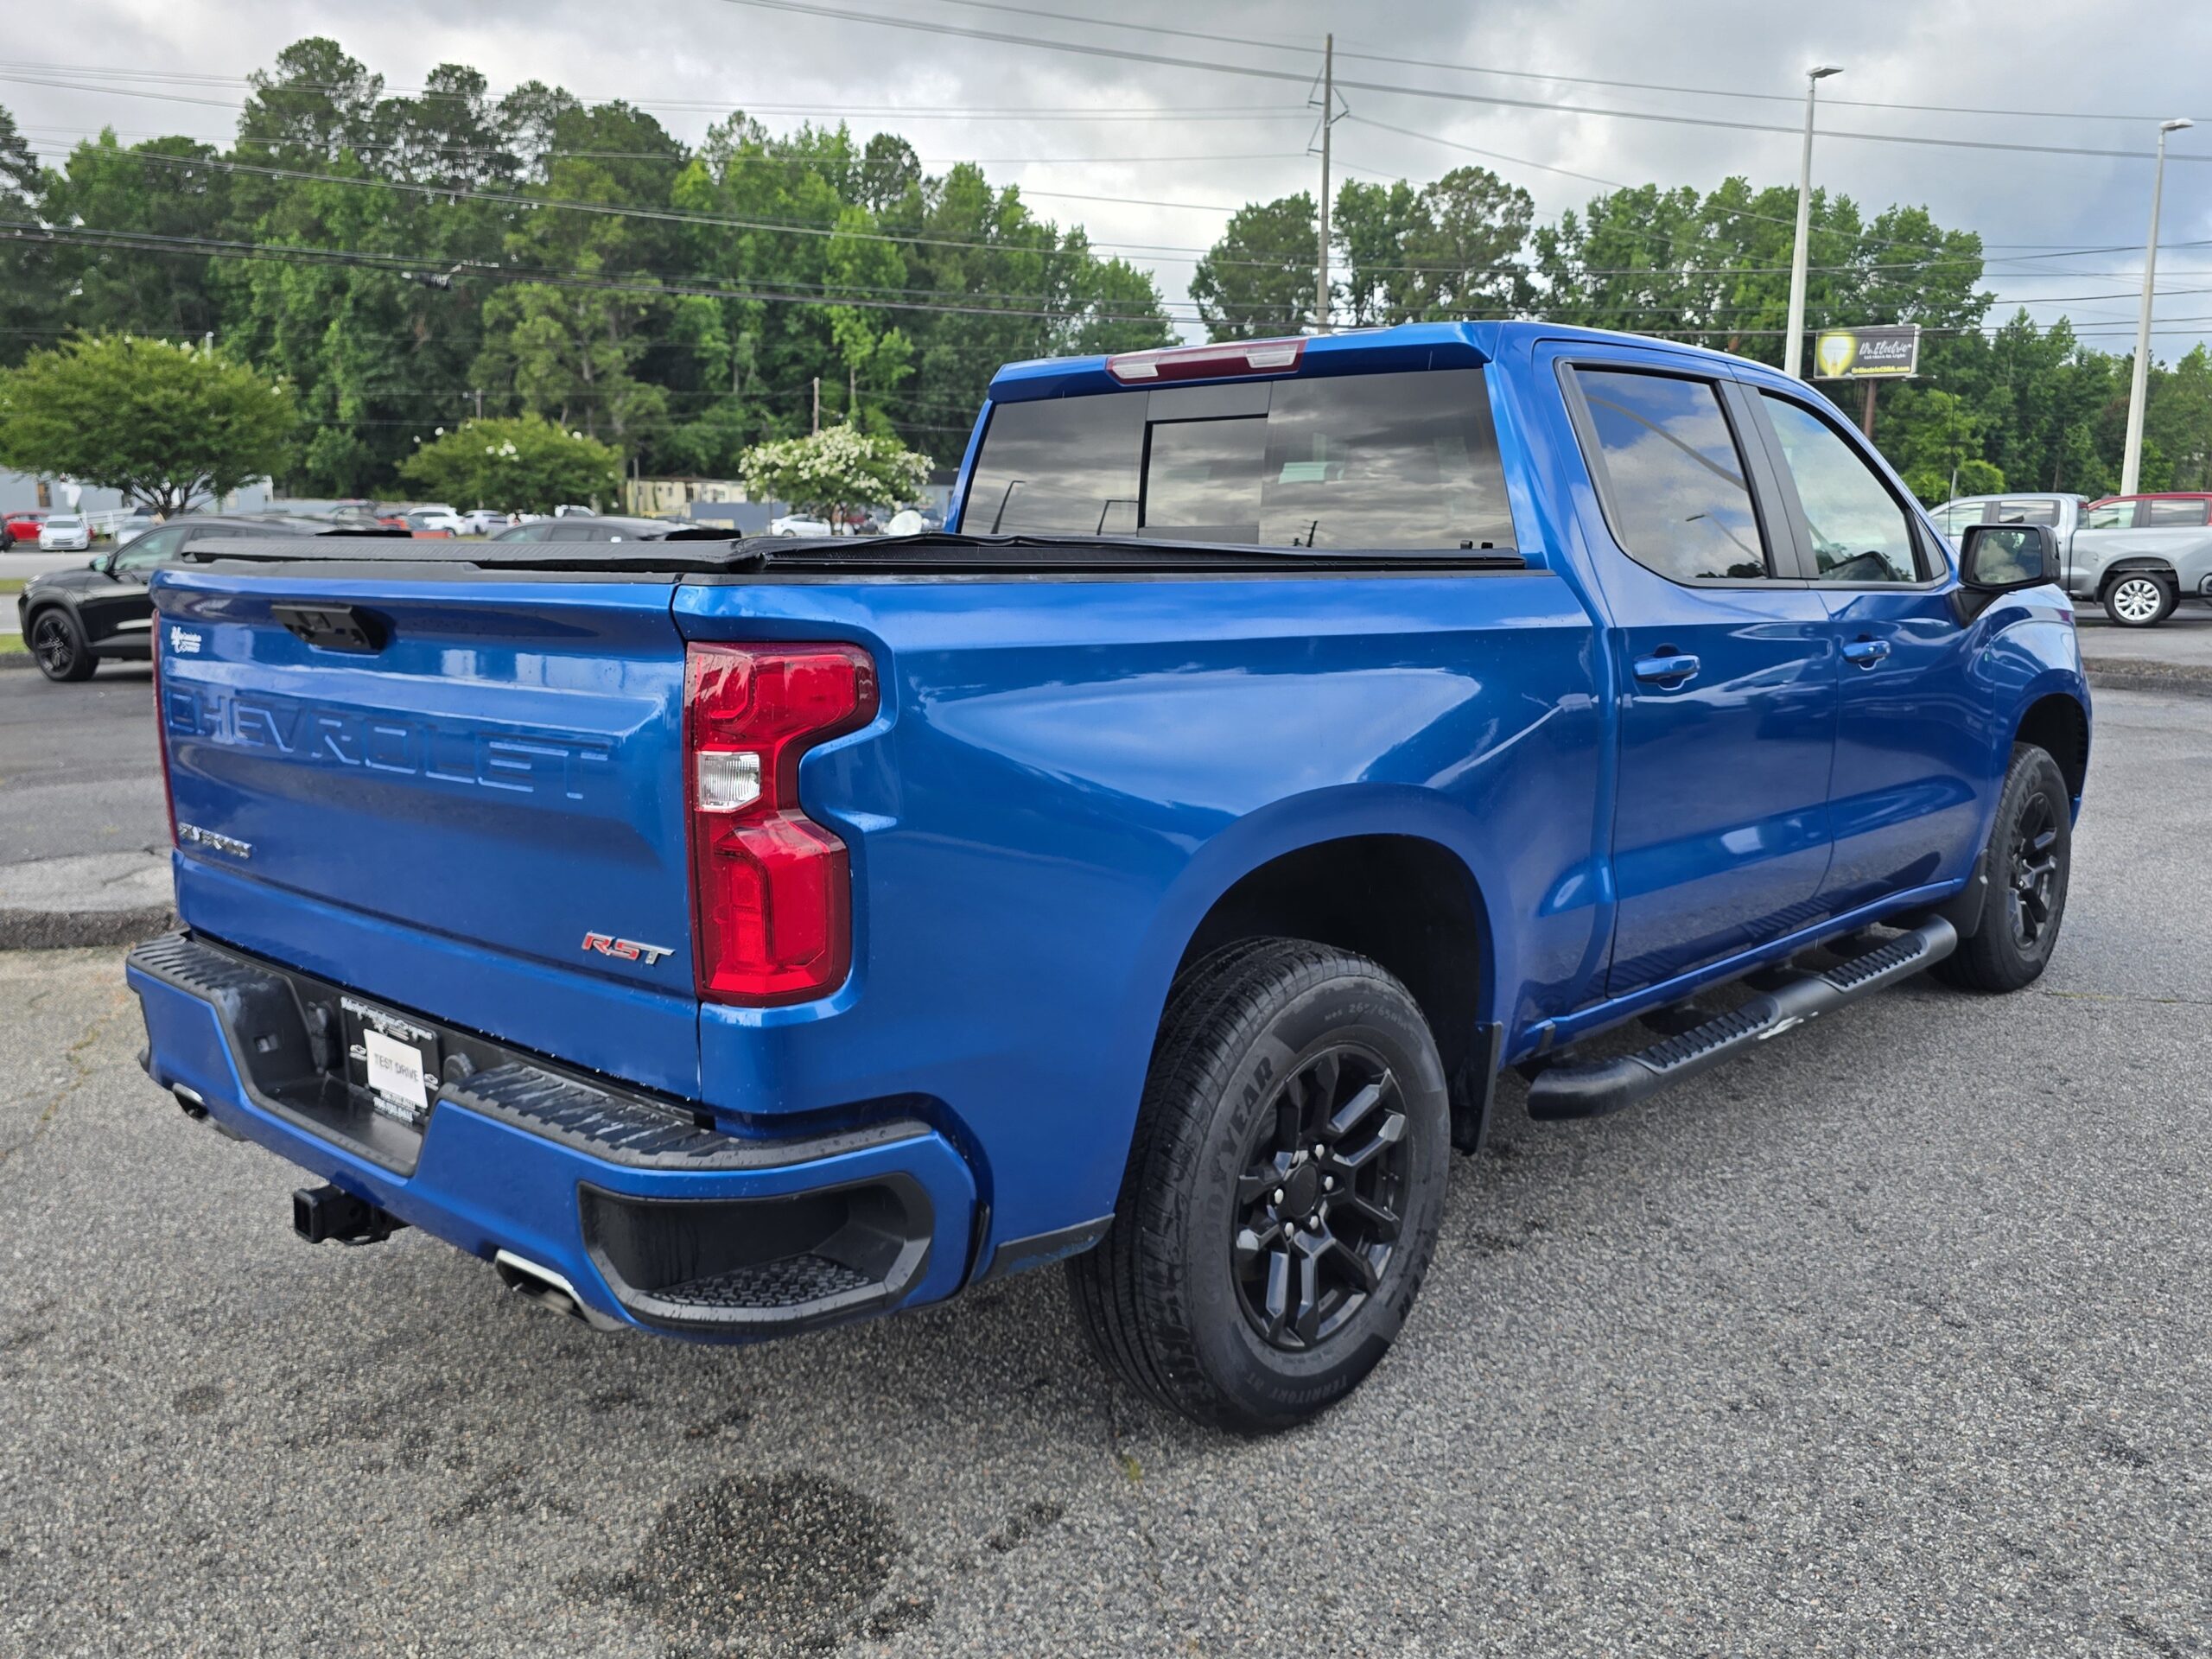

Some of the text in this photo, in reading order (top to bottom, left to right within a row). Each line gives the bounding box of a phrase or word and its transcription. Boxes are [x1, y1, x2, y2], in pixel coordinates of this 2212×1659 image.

[166, 687, 609, 799] CHEVROLET
[582, 931, 676, 965] RST
[374, 1053, 393, 1071] TEST
[395, 1062, 419, 1082] DRIVE
